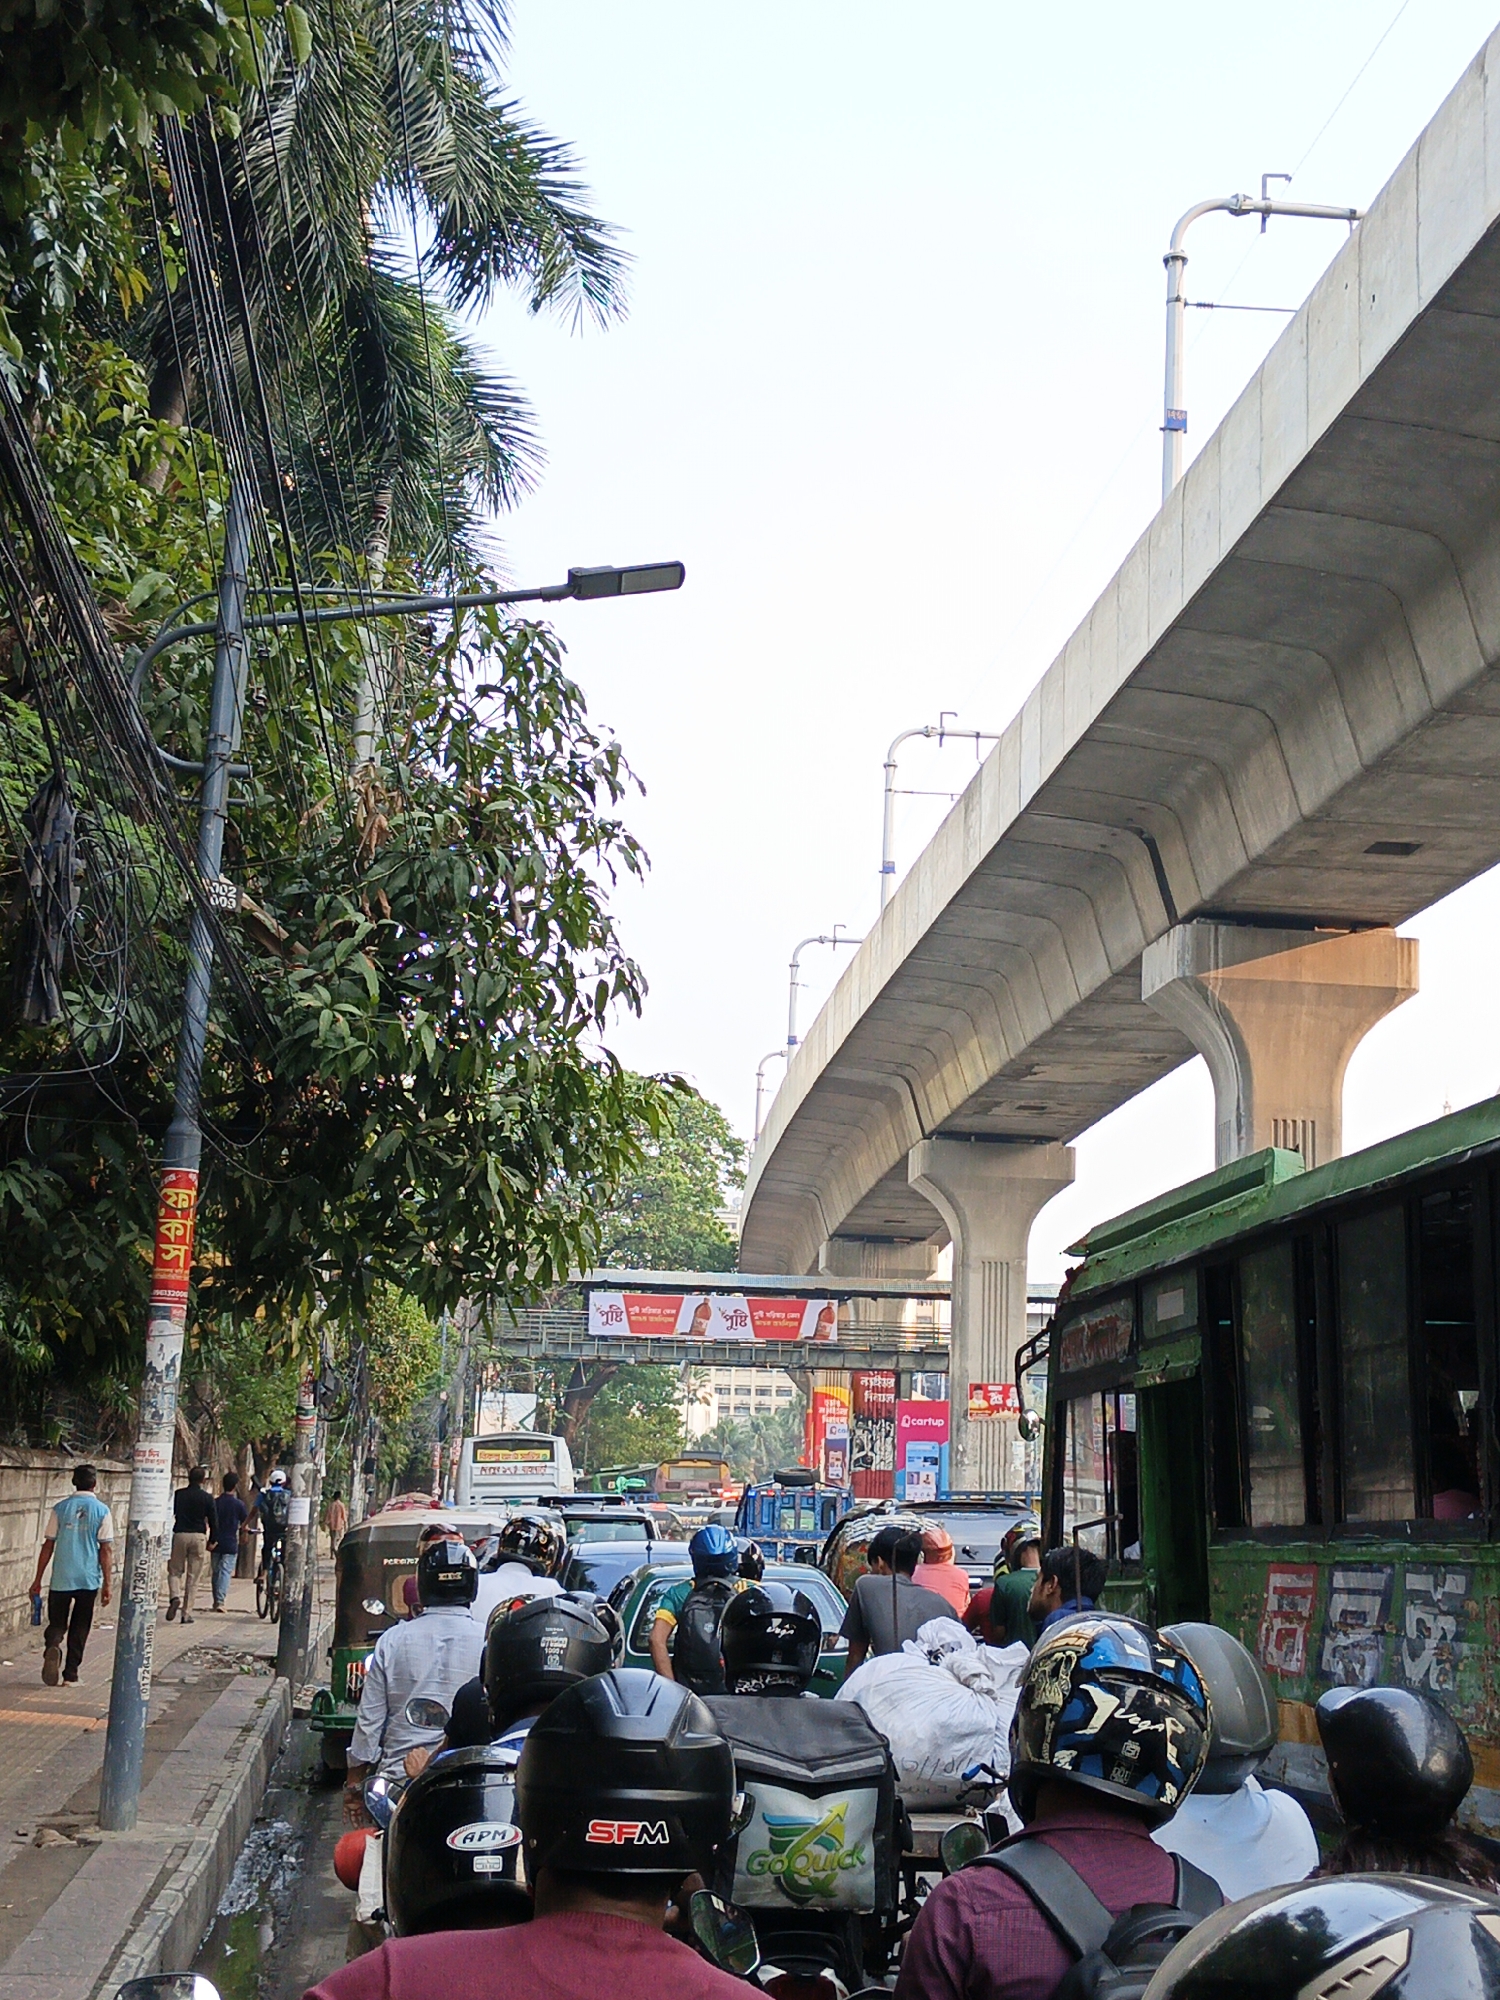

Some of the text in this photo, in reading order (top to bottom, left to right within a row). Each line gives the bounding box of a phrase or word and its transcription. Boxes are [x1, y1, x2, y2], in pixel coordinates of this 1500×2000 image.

[599, 1304, 624, 1326] পুষ্টি
[723, 1309, 748, 1331] পুষ্টি
[911, 1417, 944, 1428] cartup
[462, 1829, 508, 1845] APM
[585, 1819, 670, 1845] SFM
